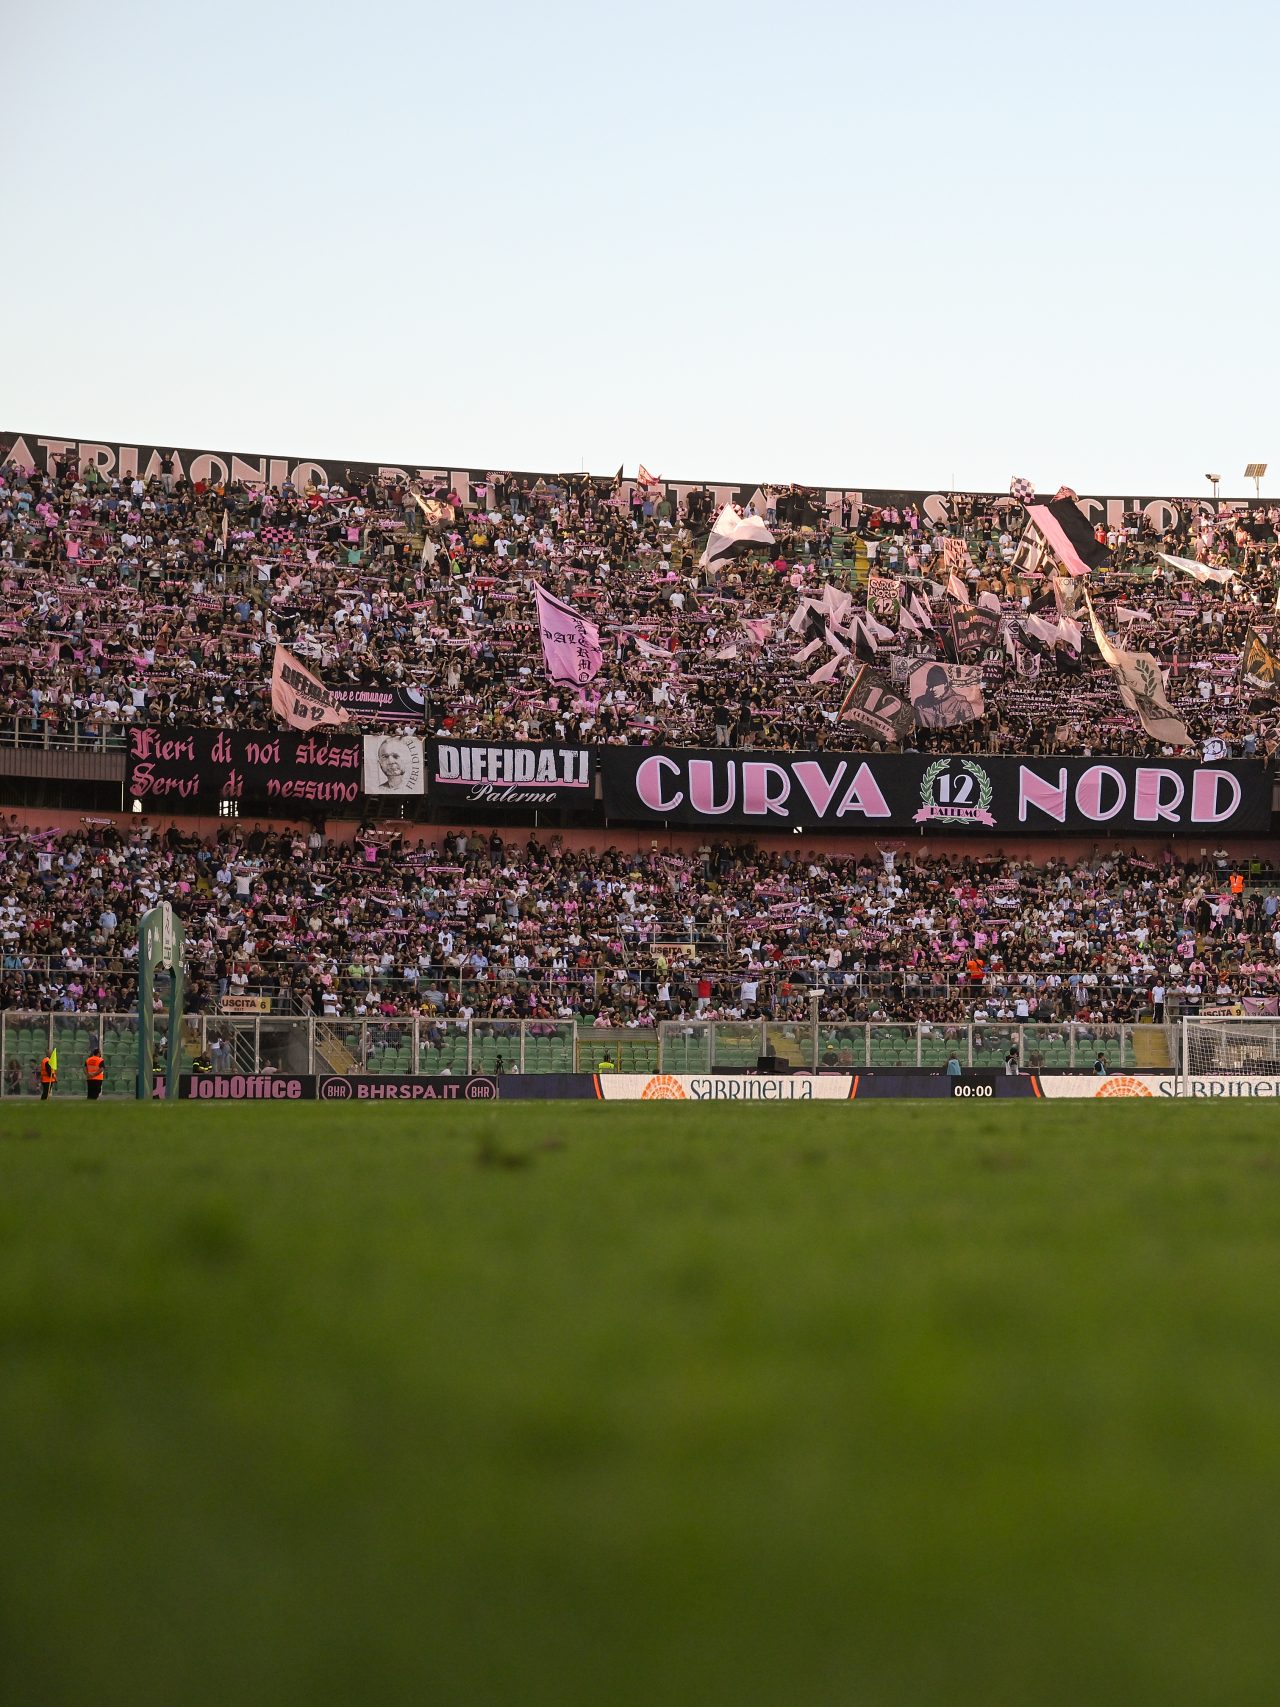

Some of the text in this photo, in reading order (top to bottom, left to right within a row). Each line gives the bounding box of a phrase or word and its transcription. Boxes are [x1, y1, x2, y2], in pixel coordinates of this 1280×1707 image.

[870, 589, 897, 598] NORD
[875, 599, 893, 614] 12
[864, 686, 902, 723] 12
[129, 728, 360, 768] Fieri di noi stessi
[438, 745, 589, 785] DIFFIDATI
[129, 763, 359, 803] Servi di nessuno
[466, 782, 557, 804] Palermo
[635, 754, 1242, 823] CURVA 12 NORD
[929, 805, 982, 819] PALERMO
[222, 999, 266, 1009] USCITA 6
[188, 1076, 302, 1099] JobOffice
[328, 1084, 490, 1098] BHR BHRSPA.IT BHR
[954, 1085, 993, 1098] 00:00
